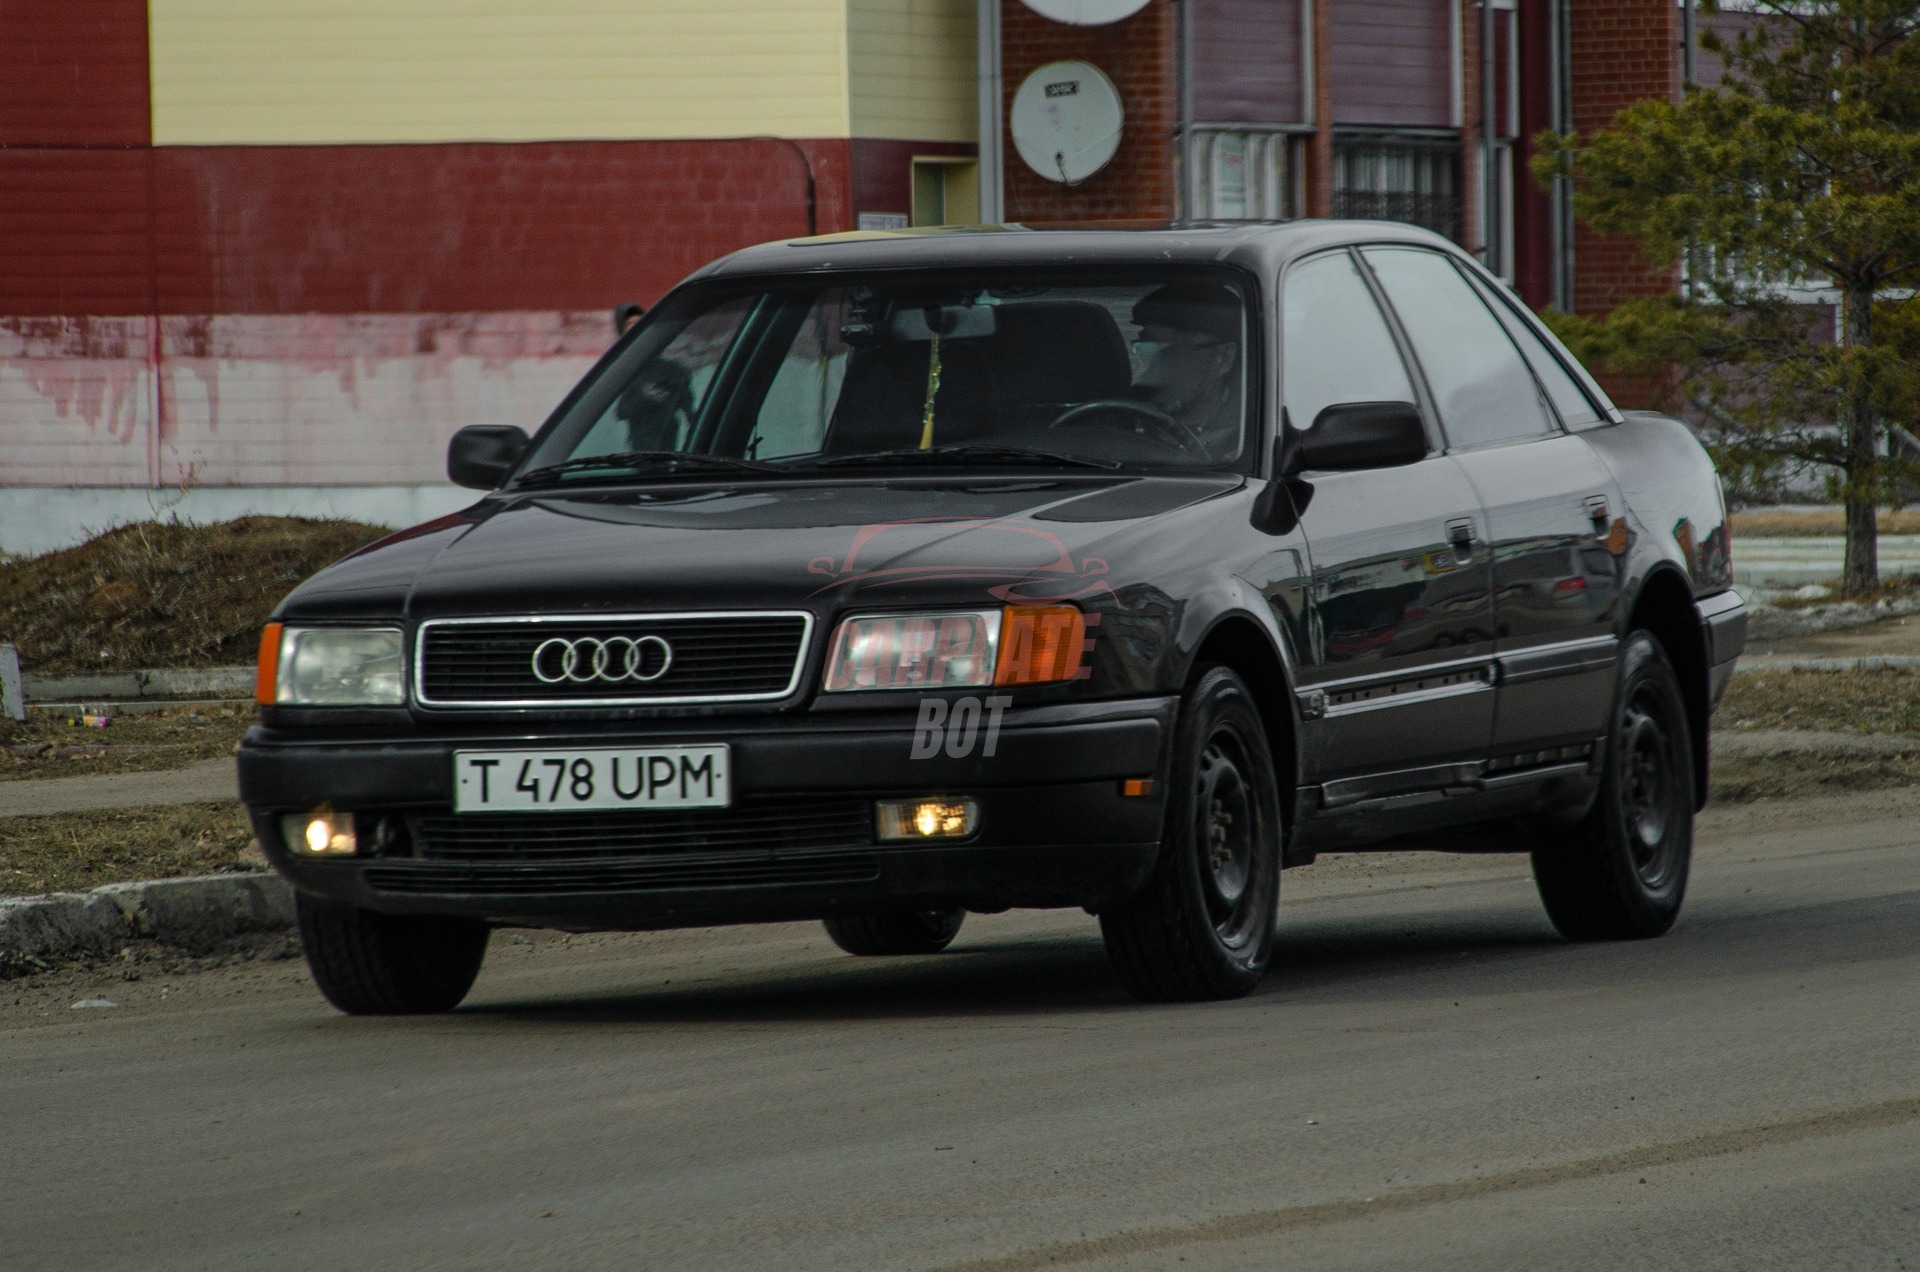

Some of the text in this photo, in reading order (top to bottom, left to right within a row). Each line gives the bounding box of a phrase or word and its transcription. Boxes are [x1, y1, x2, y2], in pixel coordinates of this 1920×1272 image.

[470, 754, 714, 803] T 478 UPM
